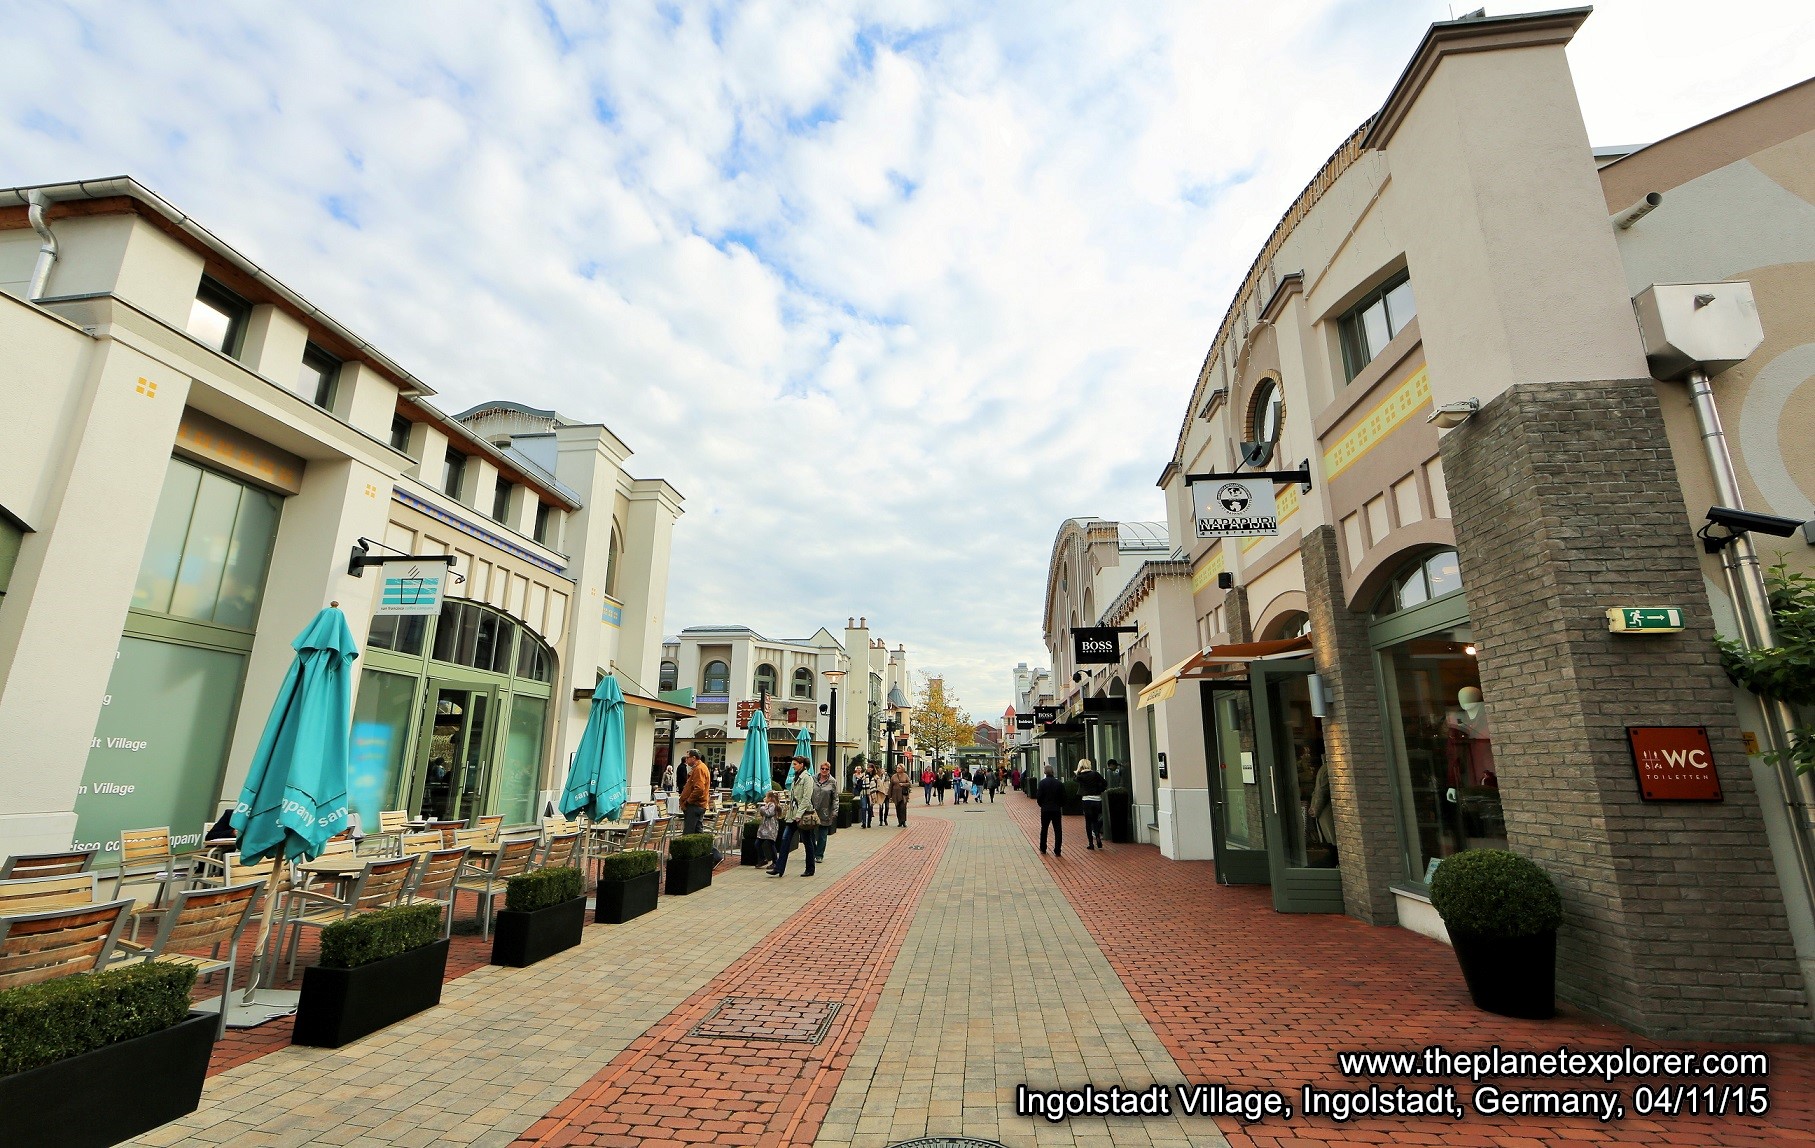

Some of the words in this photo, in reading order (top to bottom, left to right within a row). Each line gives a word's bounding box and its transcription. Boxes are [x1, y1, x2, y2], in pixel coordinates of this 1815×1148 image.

[1200, 517, 1276, 531] NAPAPIJRI
[1082, 641, 1113, 650] BOSS
[107, 737, 147, 752] Village
[1661, 749, 1708, 769] WC
[93, 783, 135, 796] Village
[574, 790, 589, 801] san
[609, 791, 622, 802] san
[318, 806, 349, 827] san
